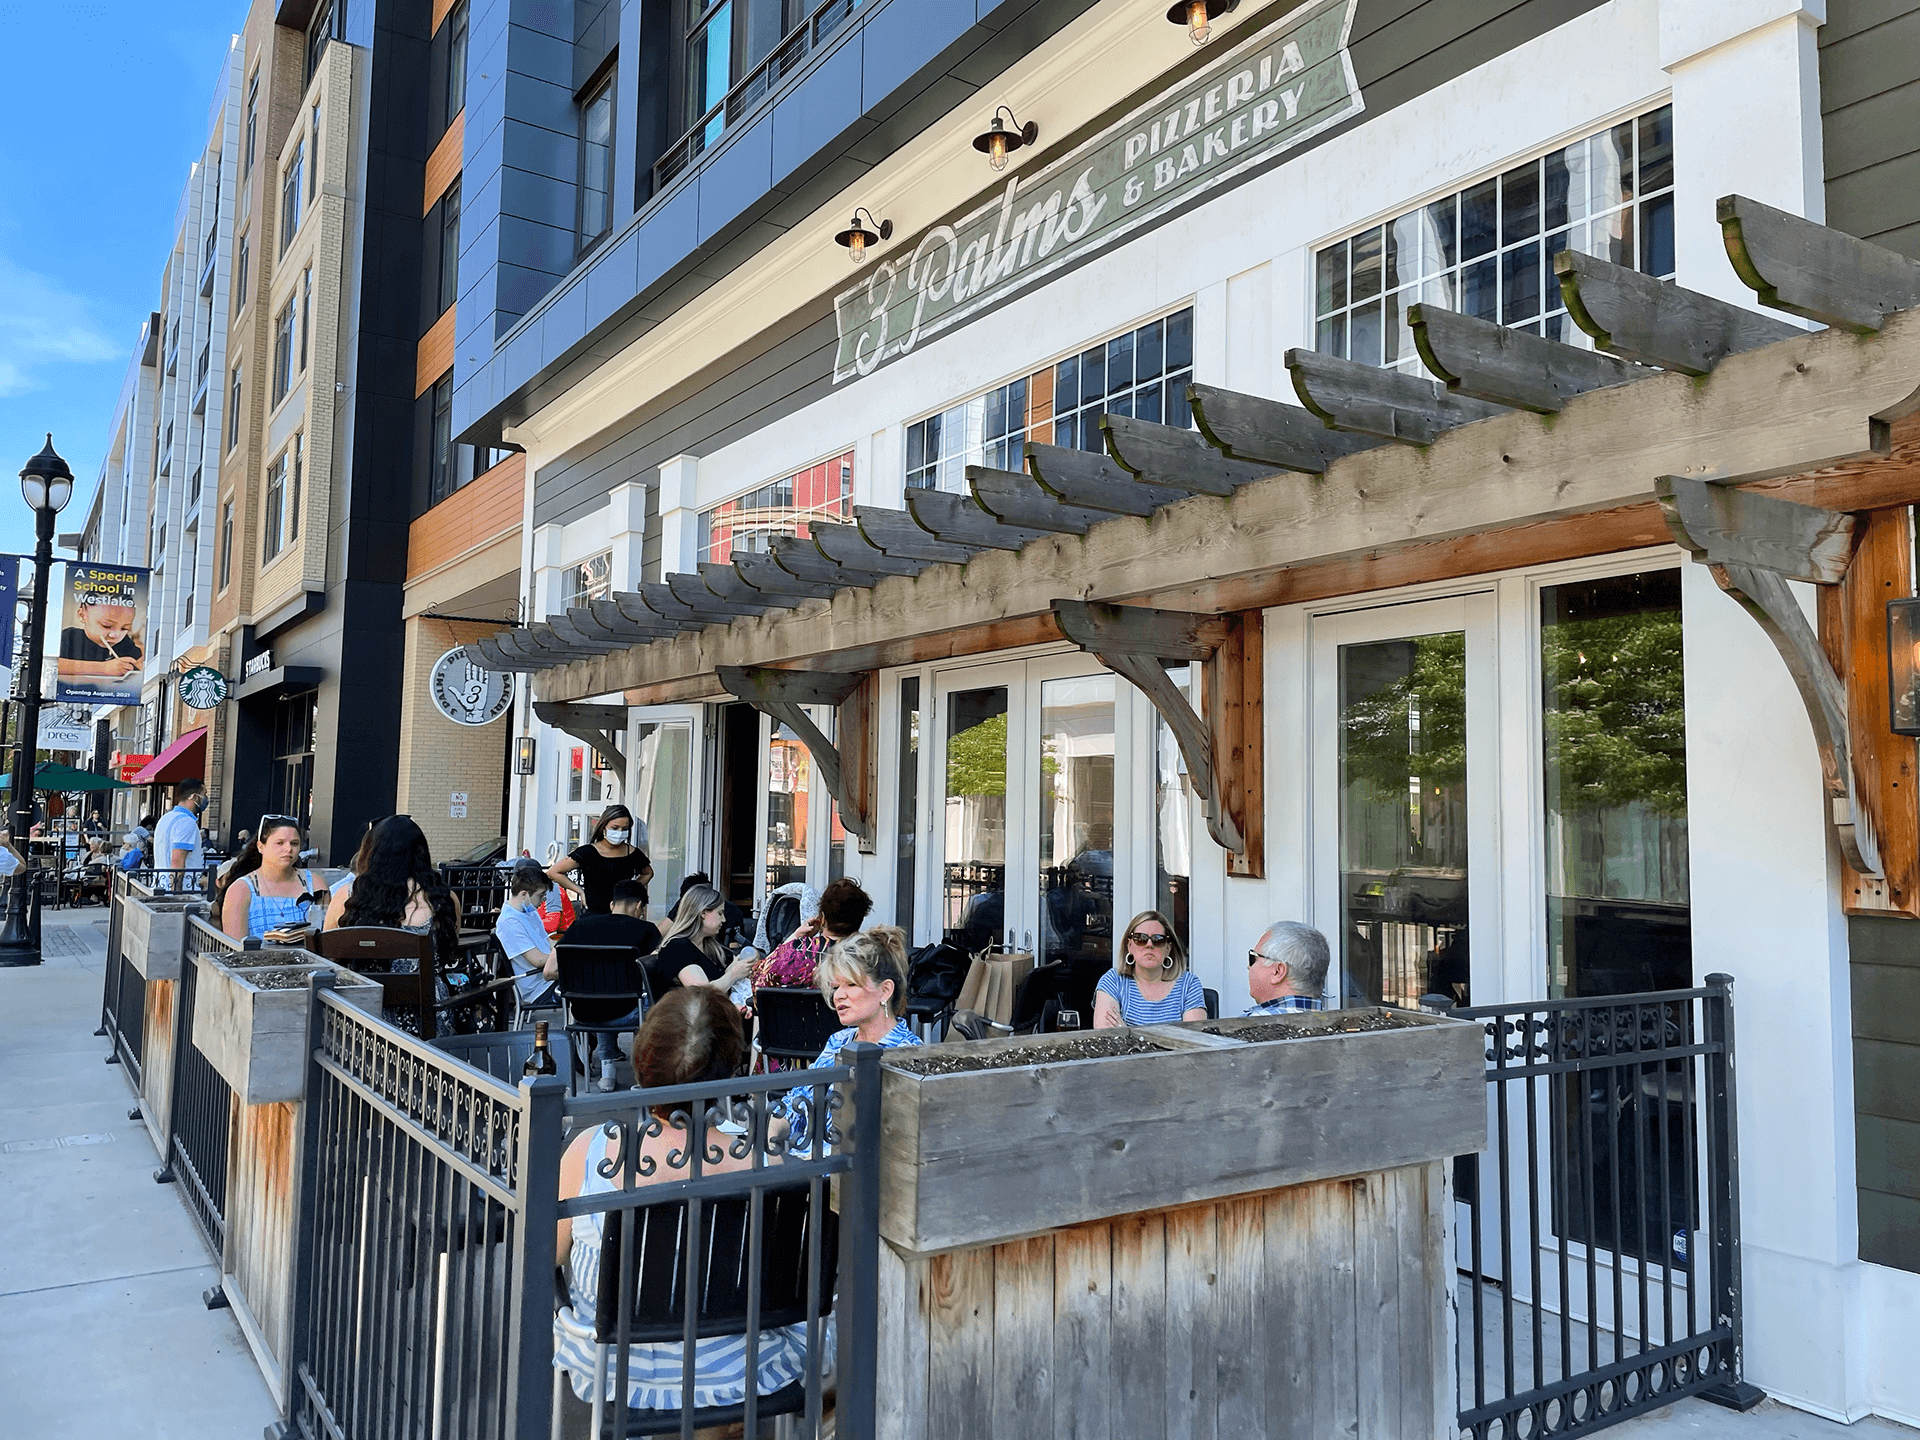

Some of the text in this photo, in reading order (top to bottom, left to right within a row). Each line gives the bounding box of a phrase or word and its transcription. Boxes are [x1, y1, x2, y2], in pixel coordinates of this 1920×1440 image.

[1124, 40, 1306, 171] PIZZERIA
[1122, 81, 1306, 208] & BAKERY
[855, 166, 1108, 376] 3 Palms
[74, 568, 138, 583] A Special
[74, 580, 136, 596] School in
[73, 592, 137, 608] Westlake.
[65, 689, 92, 697] Opening
[92, 690, 115, 698] August,
[436, 672, 451, 709] PALMS
[466, 685, 482, 704] 3
[490, 673, 511, 717] BAKERY
